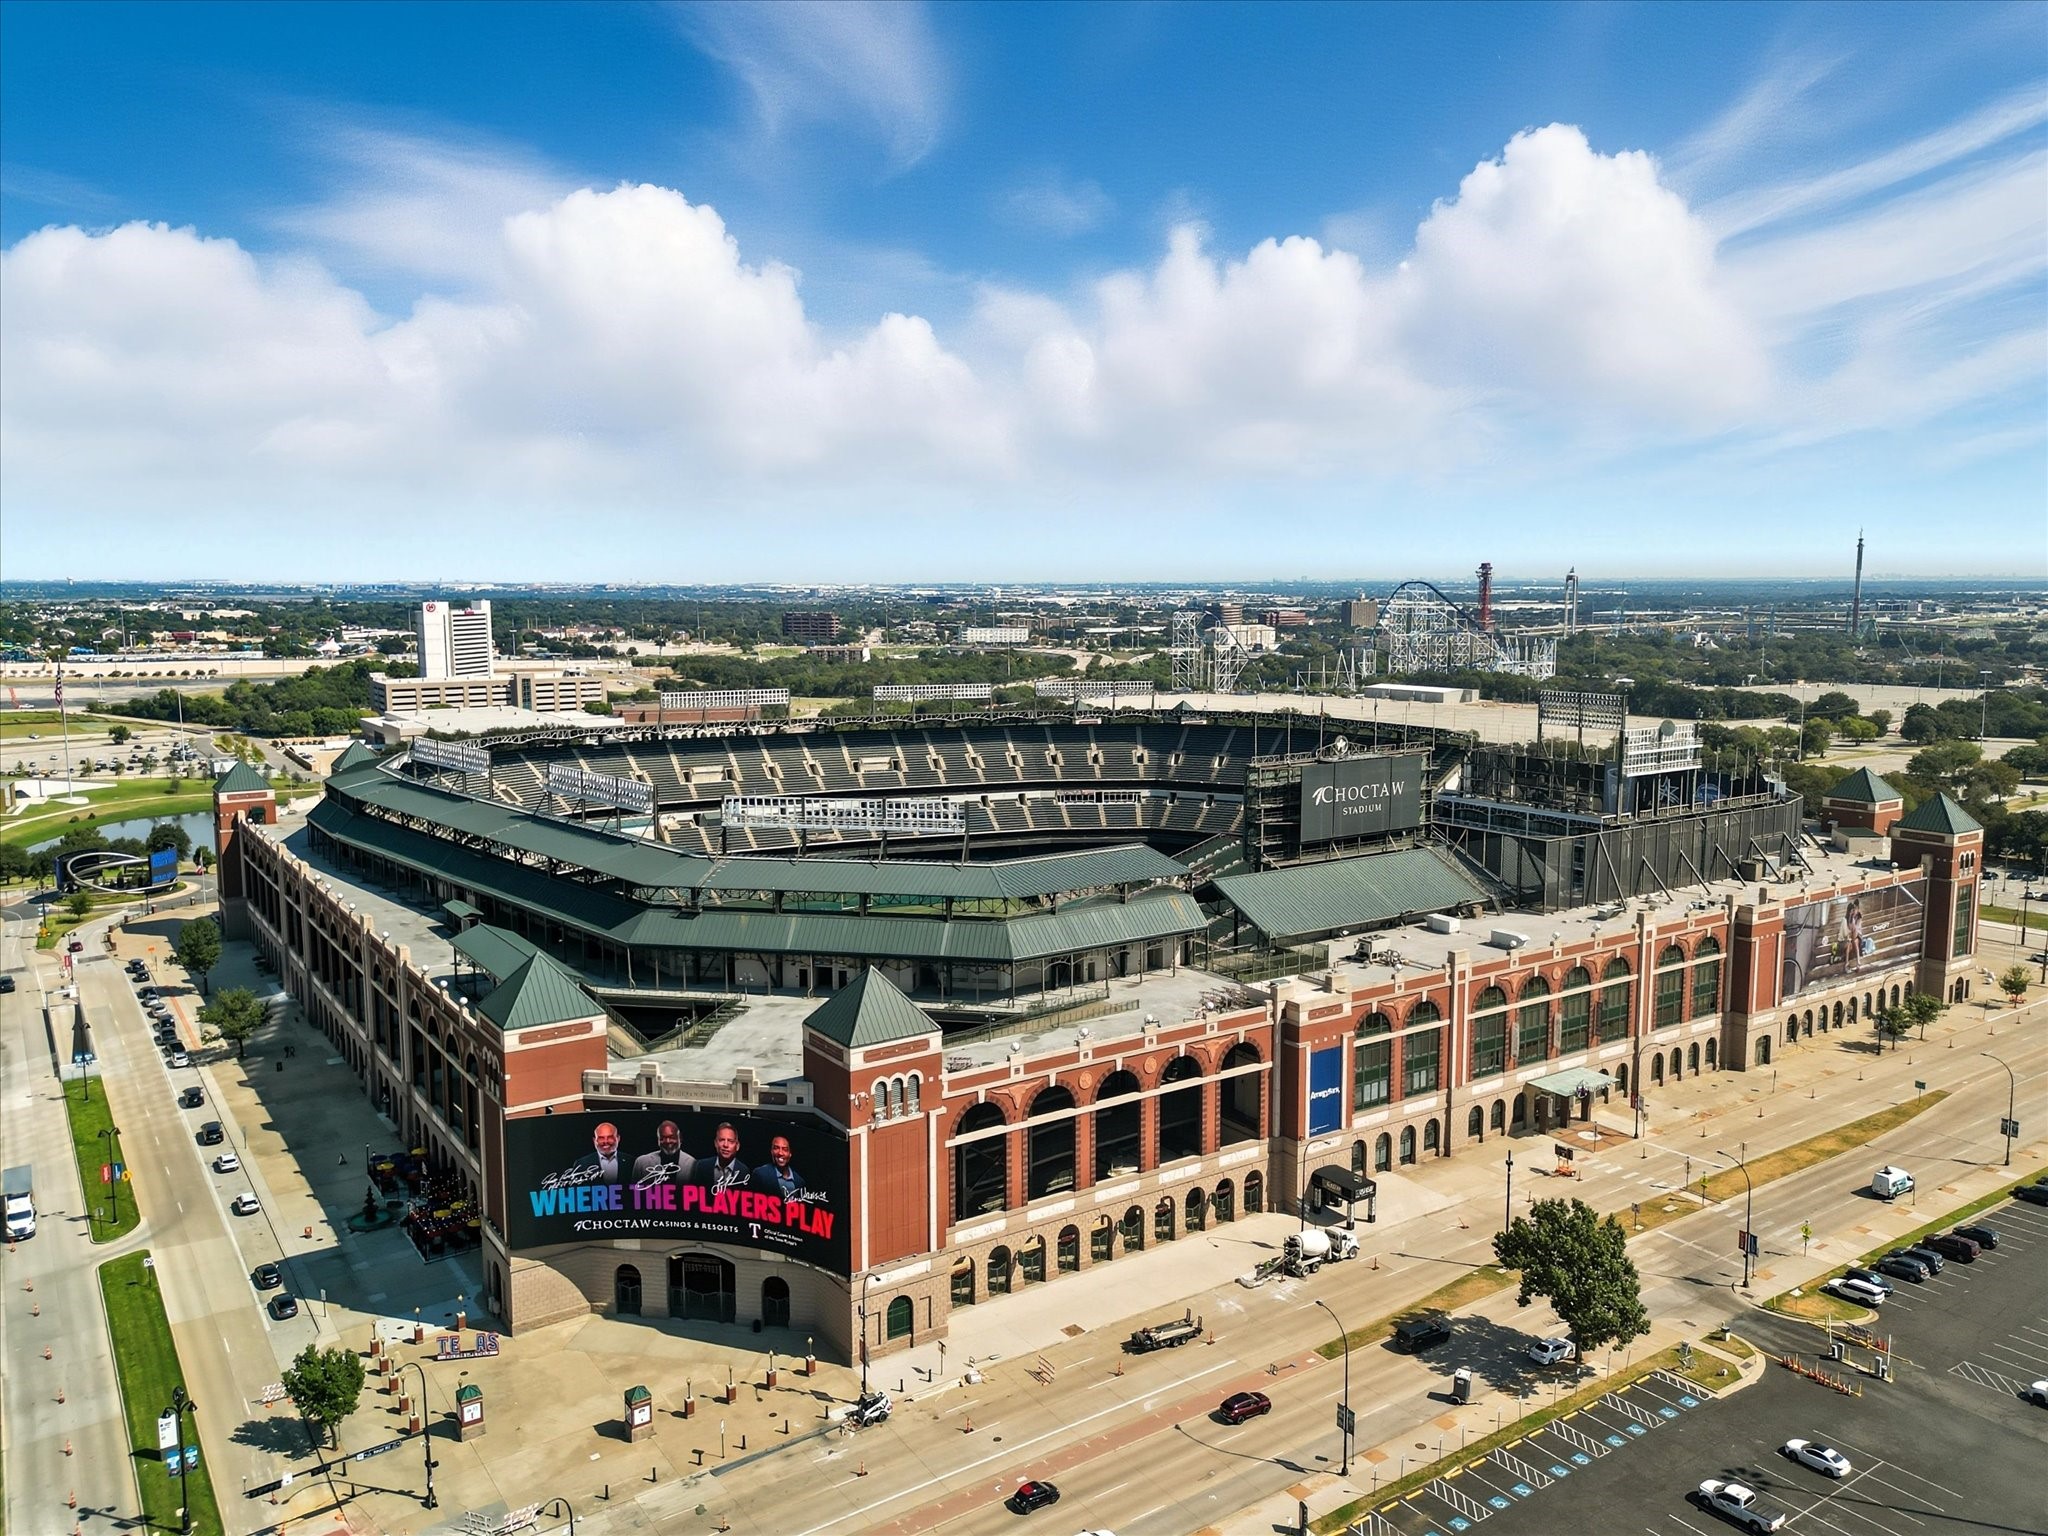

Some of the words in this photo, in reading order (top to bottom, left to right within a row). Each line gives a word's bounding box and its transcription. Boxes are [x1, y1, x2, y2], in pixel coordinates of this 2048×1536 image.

[1322, 781, 1405, 803] CHOCTAW
[1343, 804, 1382, 816] STADIUM
[530, 1185, 624, 1217] WHERE
[629, 1184, 677, 1211] THE
[683, 1185, 782, 1224] PLAYERS
[786, 1202, 835, 1239] PLAY
[582, 1219, 651, 1231] CHOCTAW
[652, 1220, 692, 1228] CASINOS
[701, 1222, 739, 1233] RESORTS
